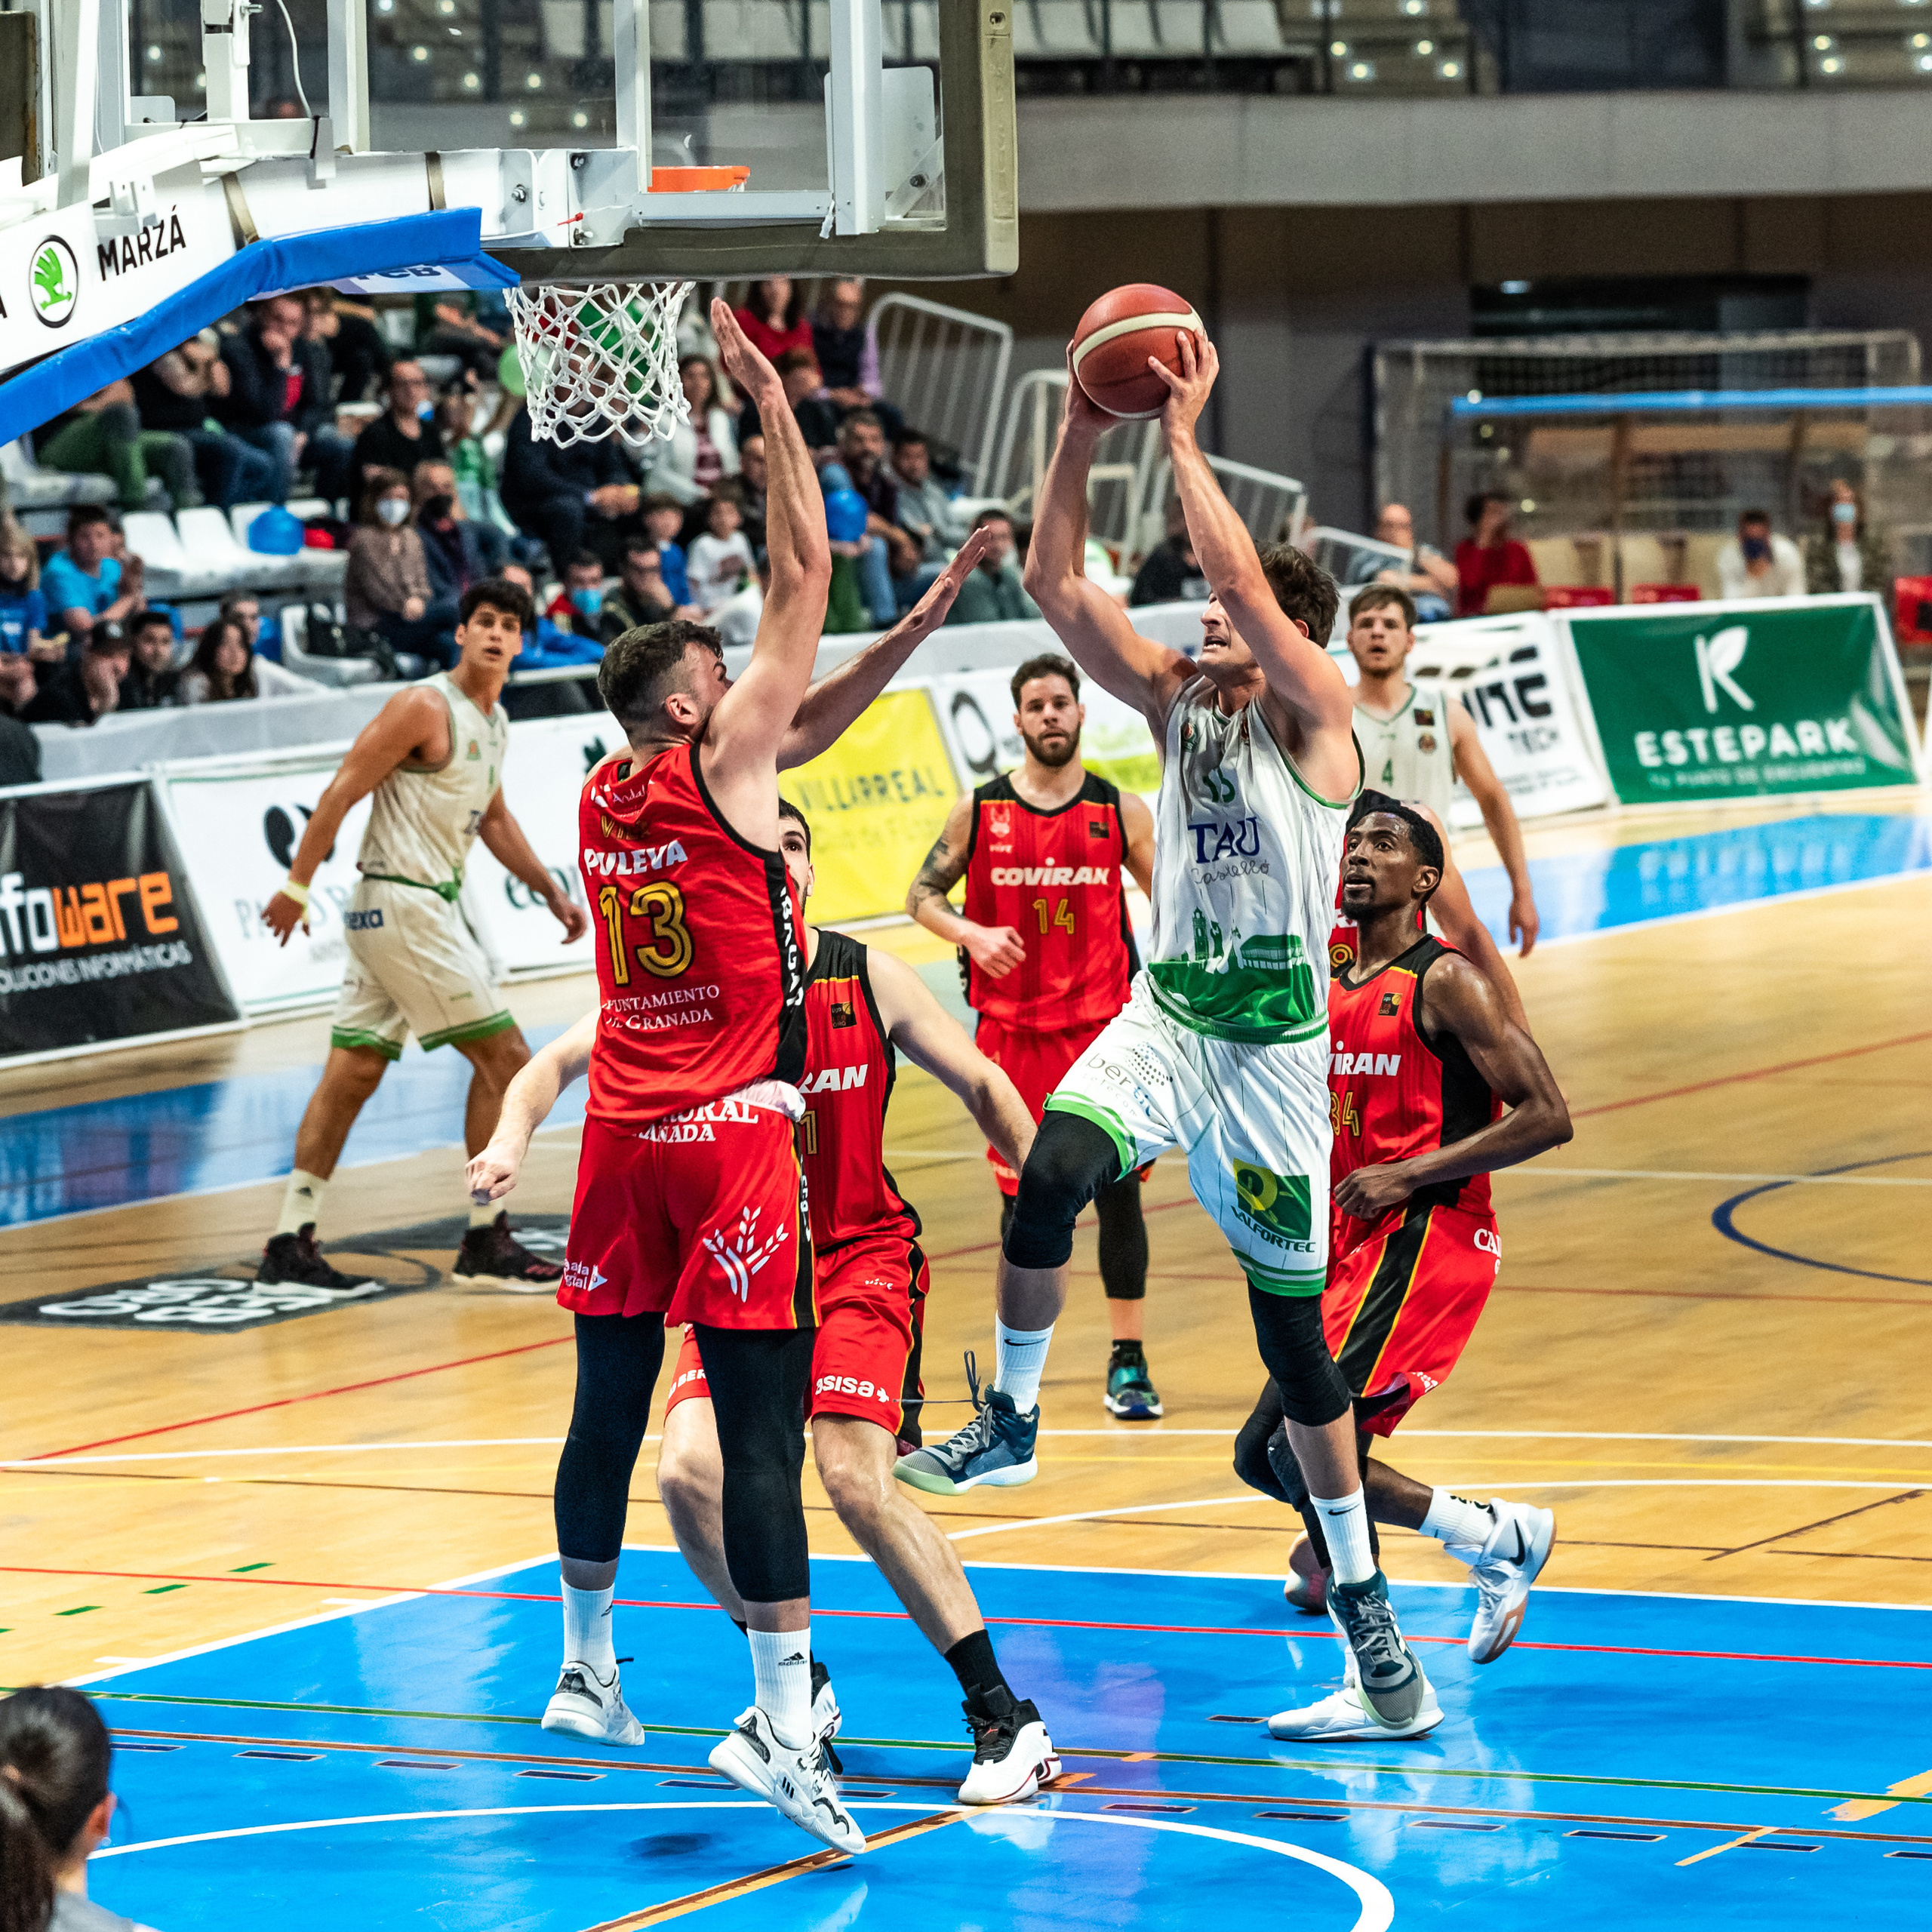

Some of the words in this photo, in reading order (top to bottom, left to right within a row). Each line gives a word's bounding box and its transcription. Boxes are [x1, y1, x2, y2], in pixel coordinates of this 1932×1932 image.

[97, 204, 186, 281] MARZÁ
[1634, 717, 1859, 768] ESTEPARK
[583, 839, 688, 876] PULEVA
[1187, 816, 1260, 864] TAU
[599, 880, 696, 987] 13
[1032, 898, 1075, 935] 14
[625, 1008, 714, 1030] GRANADA
[1330, 1091, 1360, 1137] 34
[1230, 1204, 1317, 1254] VALFORTEC
[814, 1374, 875, 1398] asisa
